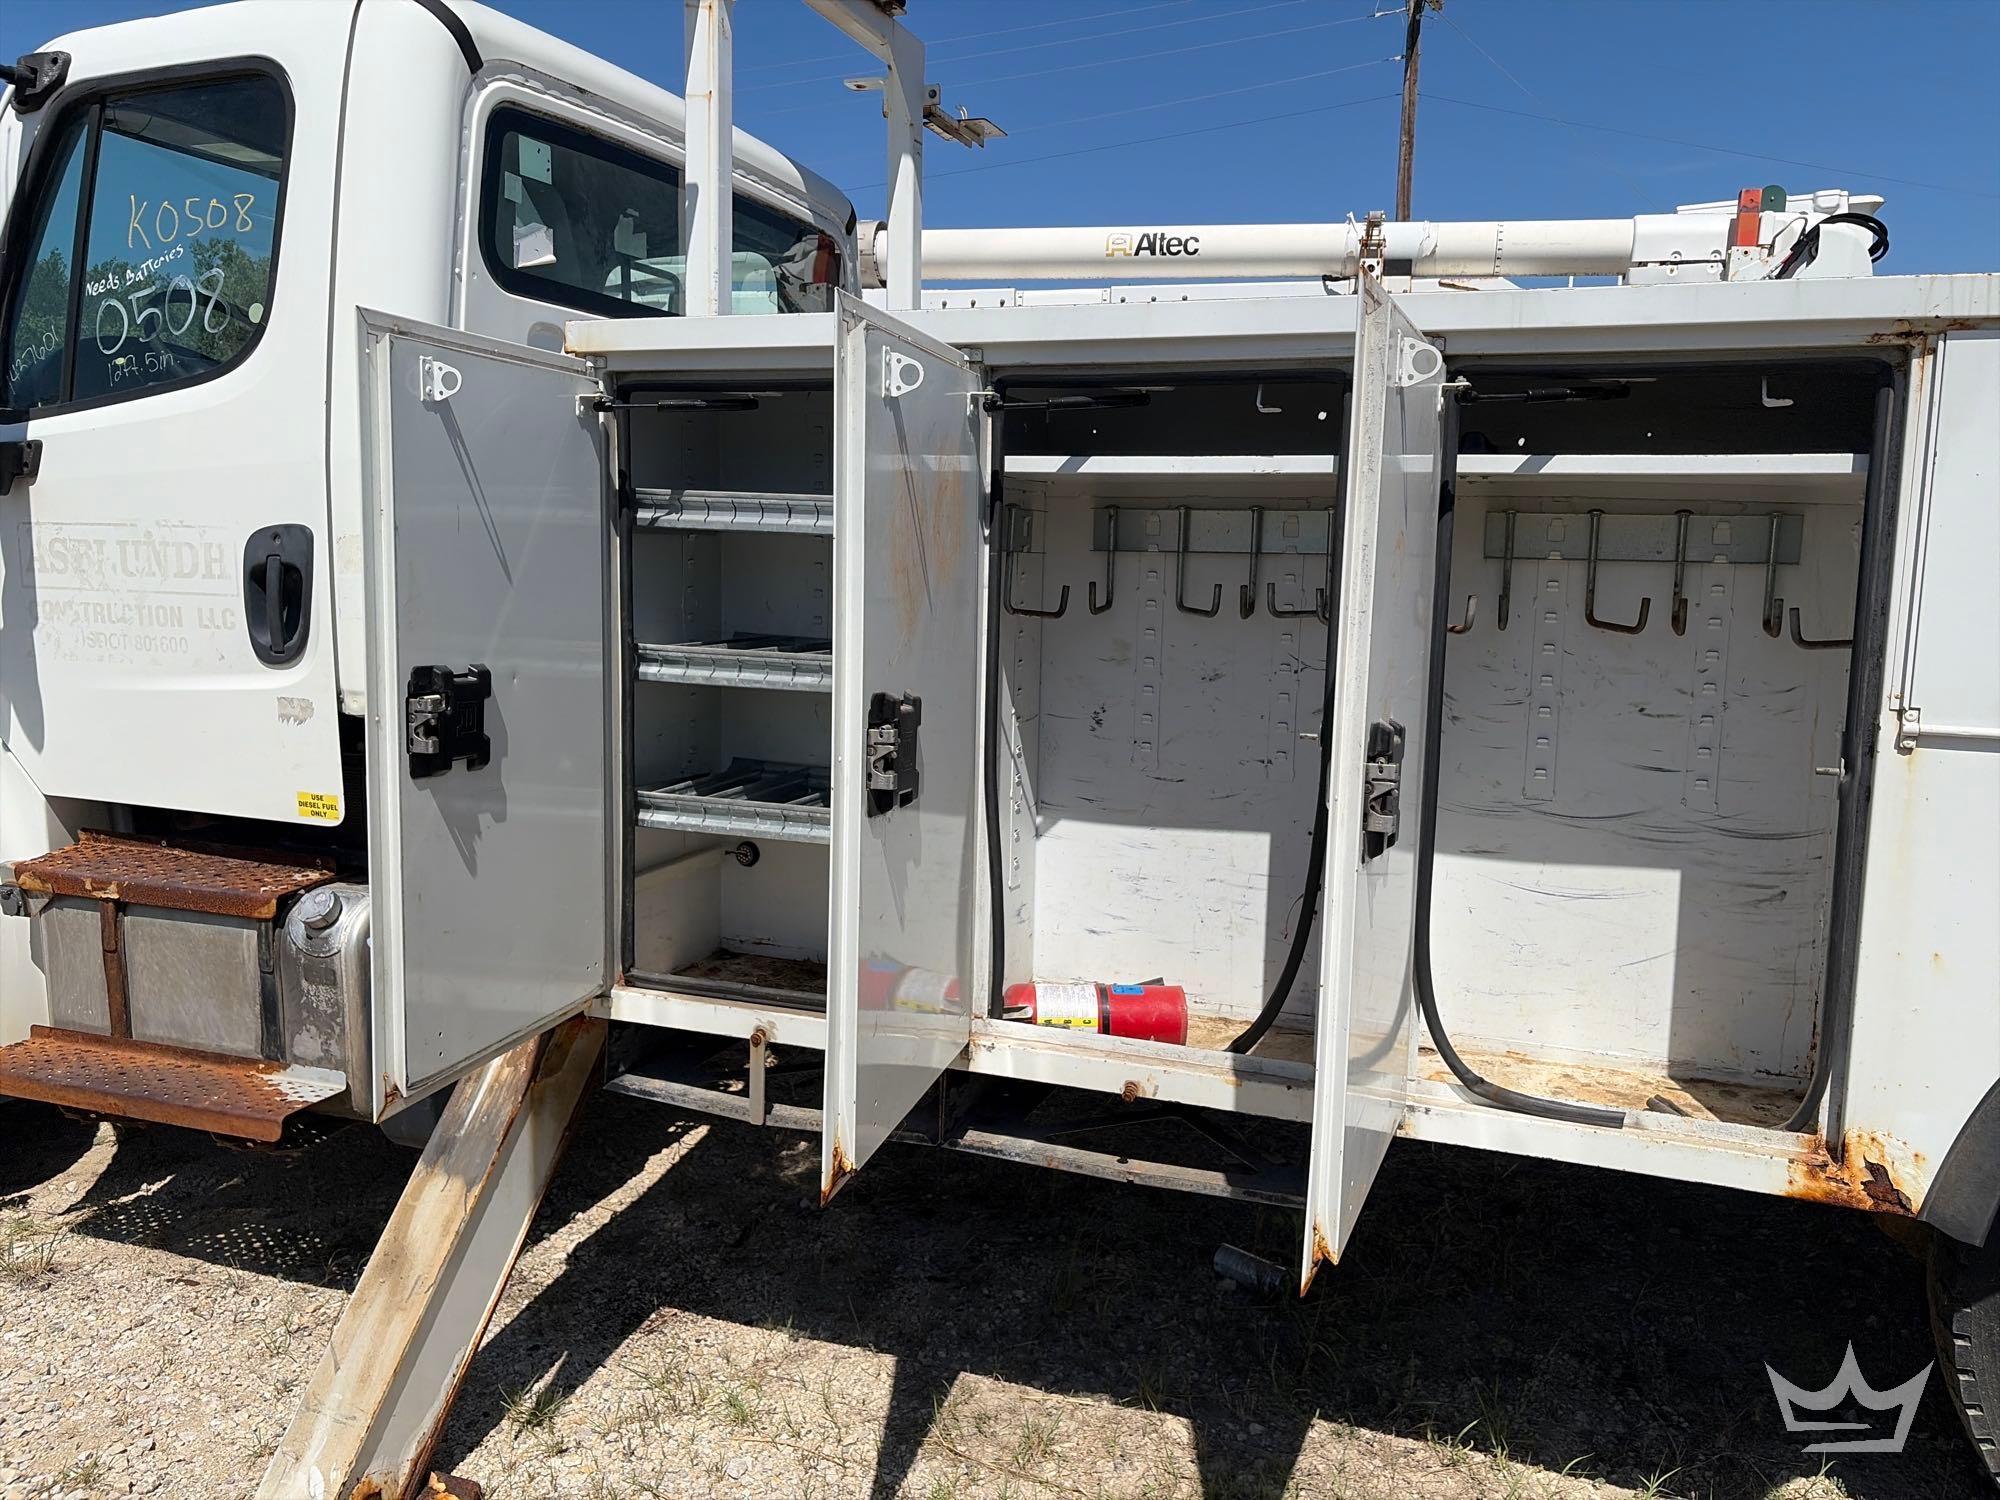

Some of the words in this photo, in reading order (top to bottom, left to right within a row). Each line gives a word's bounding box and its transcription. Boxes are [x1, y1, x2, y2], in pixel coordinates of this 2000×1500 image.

[1133, 232, 1200, 256] Altec
[85, 272, 120, 297] Needs
[197, 606, 236, 630] LLC
[298, 801, 320, 809] DIESEL
